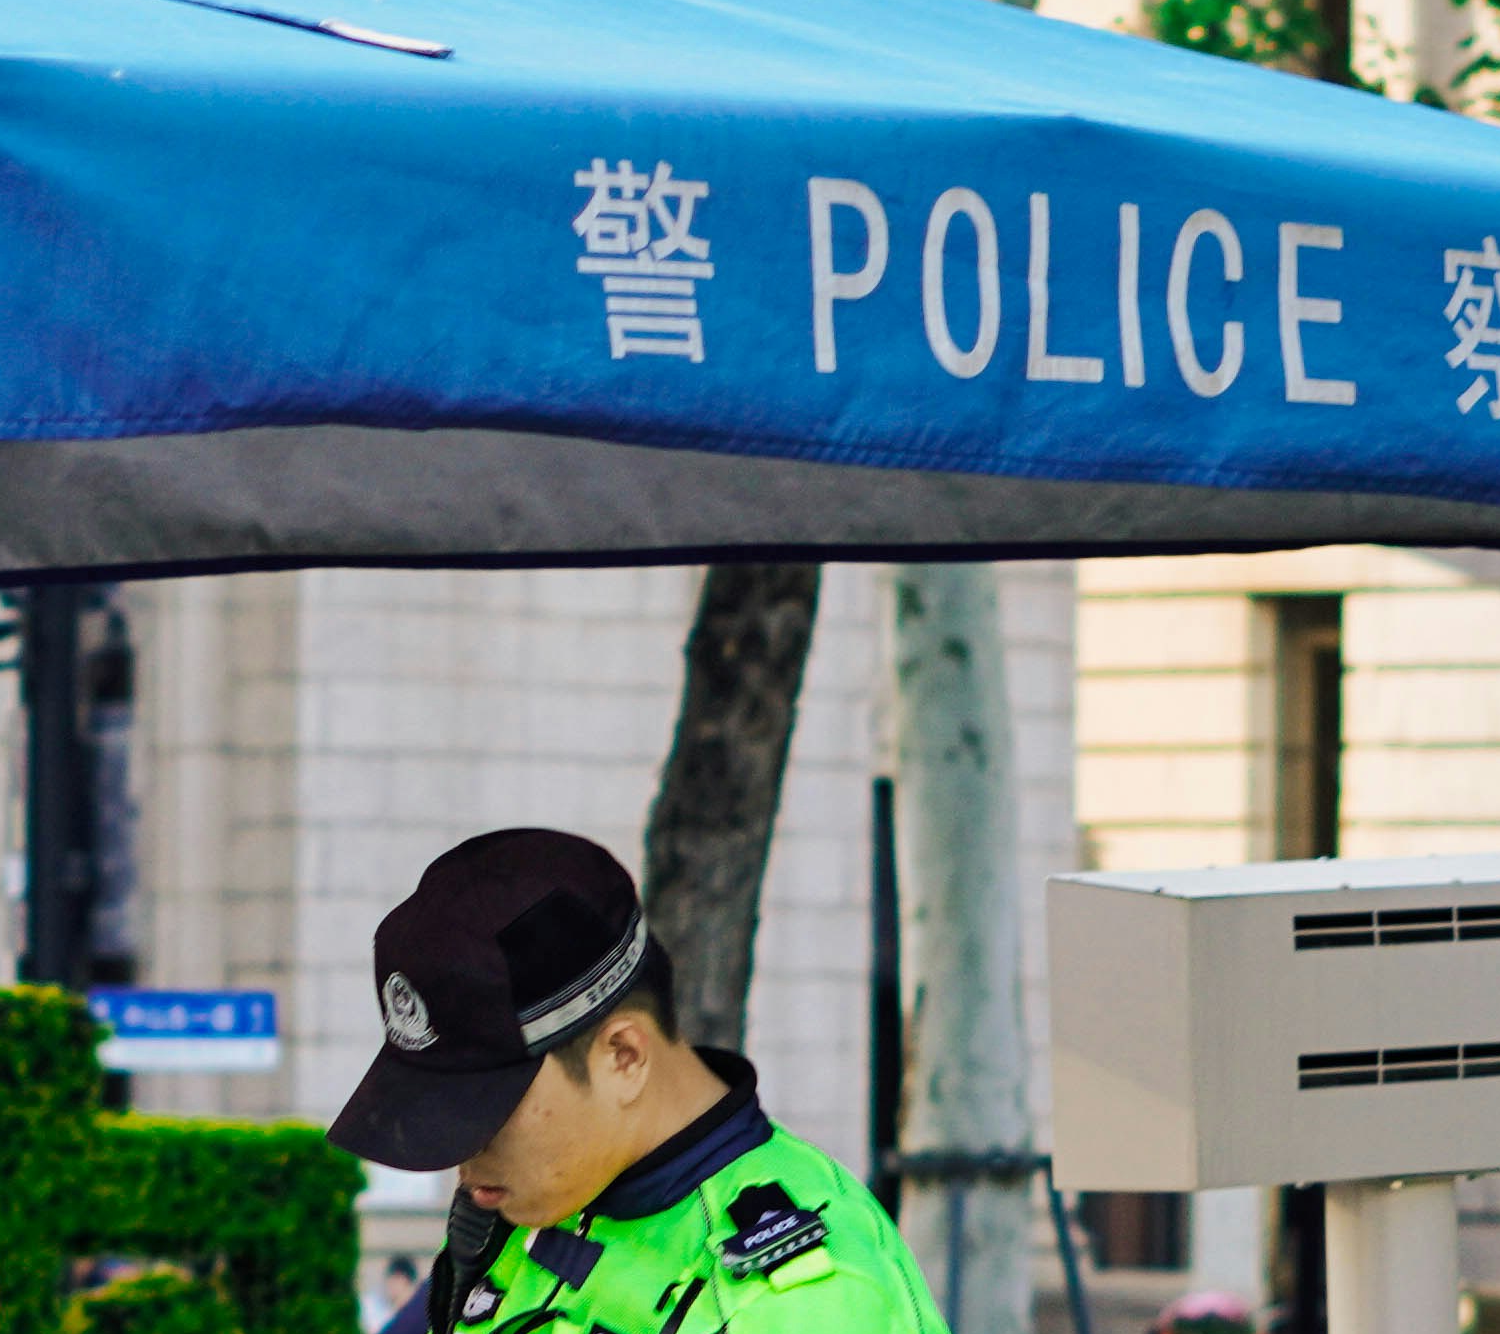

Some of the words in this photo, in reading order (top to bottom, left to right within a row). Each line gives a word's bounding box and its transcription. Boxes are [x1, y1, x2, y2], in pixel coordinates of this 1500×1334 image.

[572, 157, 715, 364] 警
[808, 176, 1358, 406] POLICE
[743, 1214, 800, 1249] POLICE
